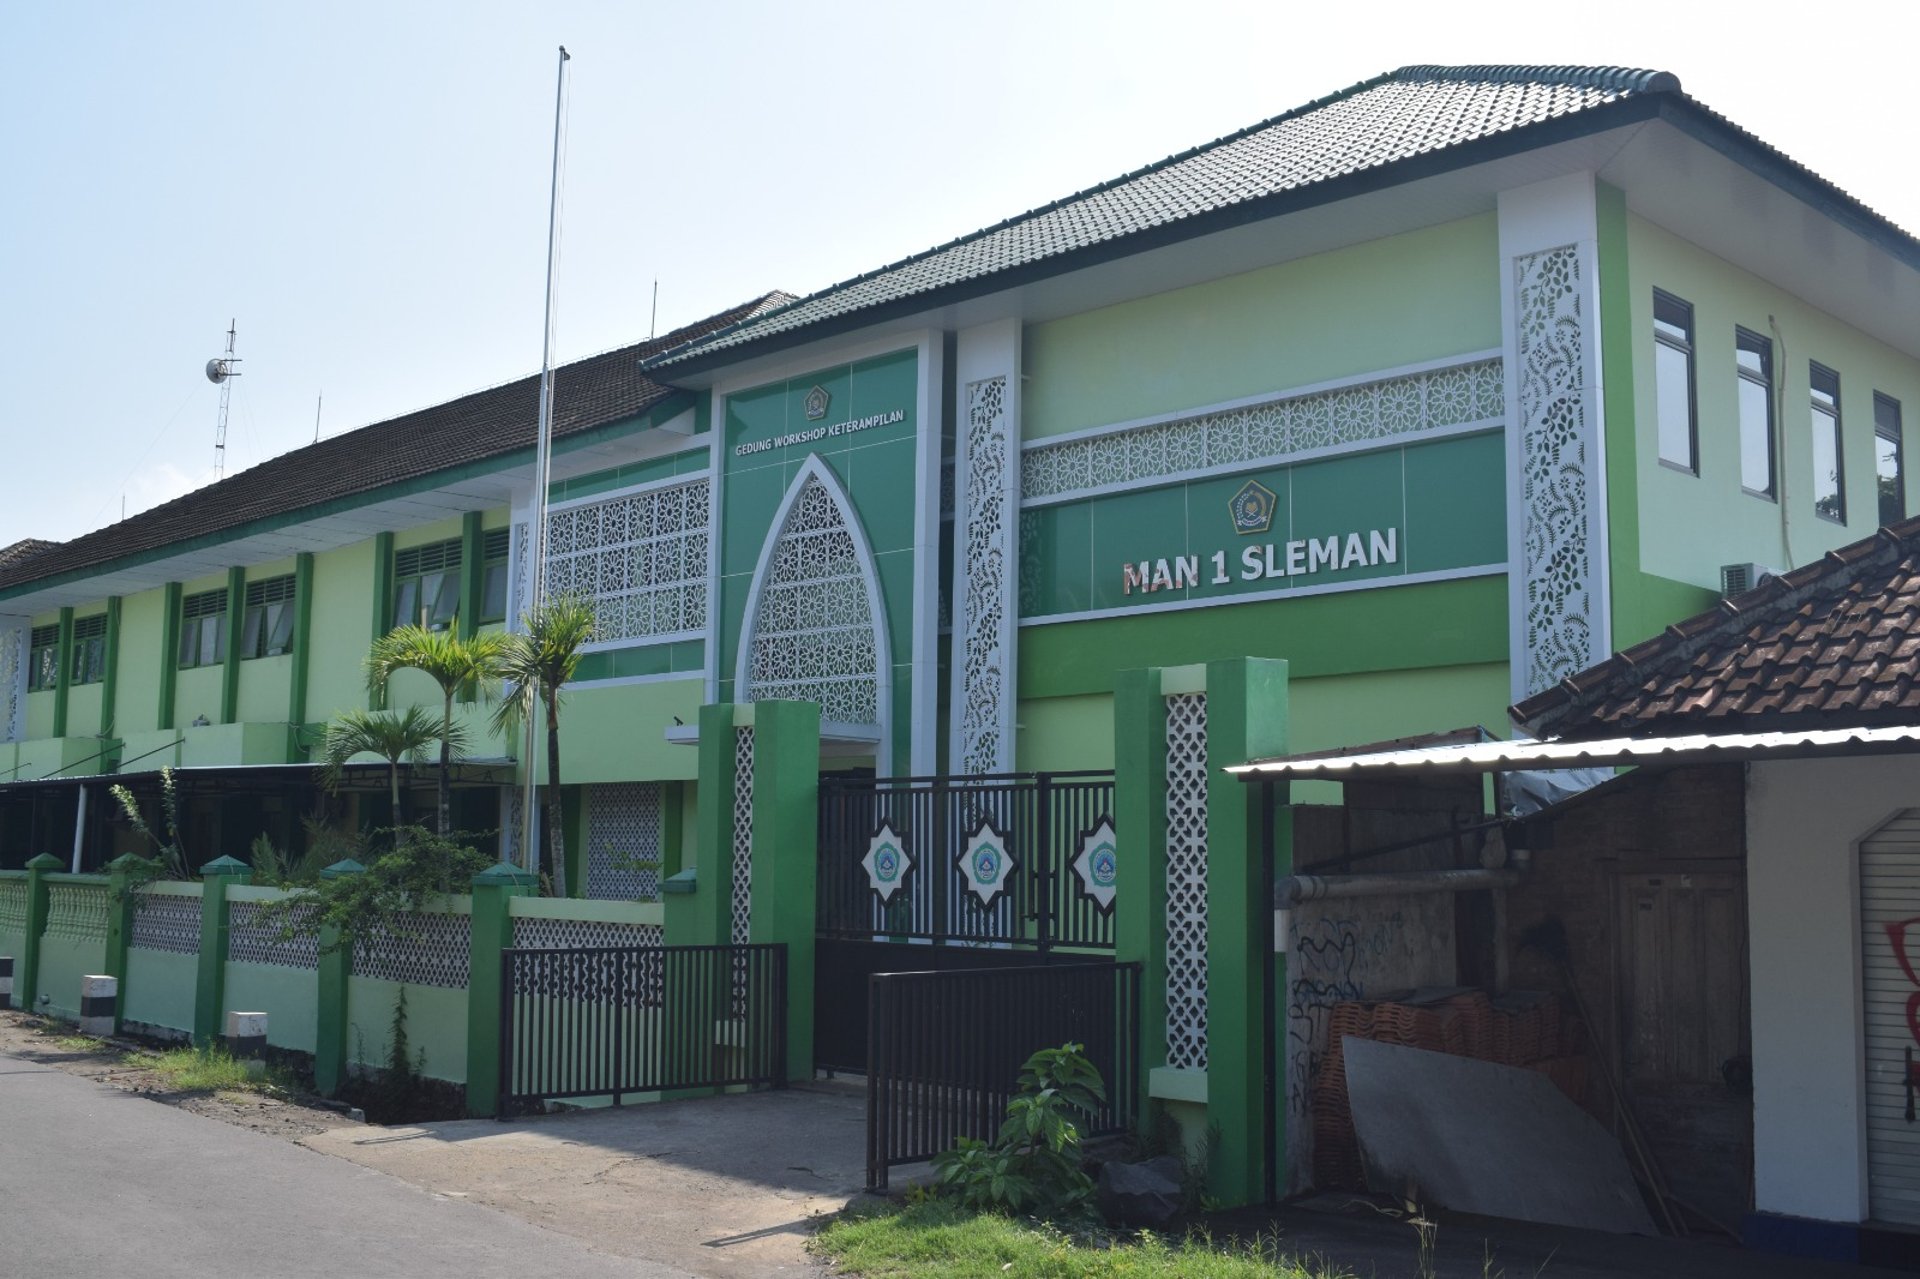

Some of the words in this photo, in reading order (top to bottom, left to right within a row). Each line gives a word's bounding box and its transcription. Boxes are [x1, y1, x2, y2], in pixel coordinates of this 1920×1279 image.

[736, 438, 772, 456] GEDUNG
[774, 427, 826, 448] WORKSHOP
[828, 410, 904, 437] KETERAMPILAN
[1123, 554, 1199, 595] MAN
[1211, 550, 1230, 584] 1
[1241, 527, 1397, 581] SLEMAN
